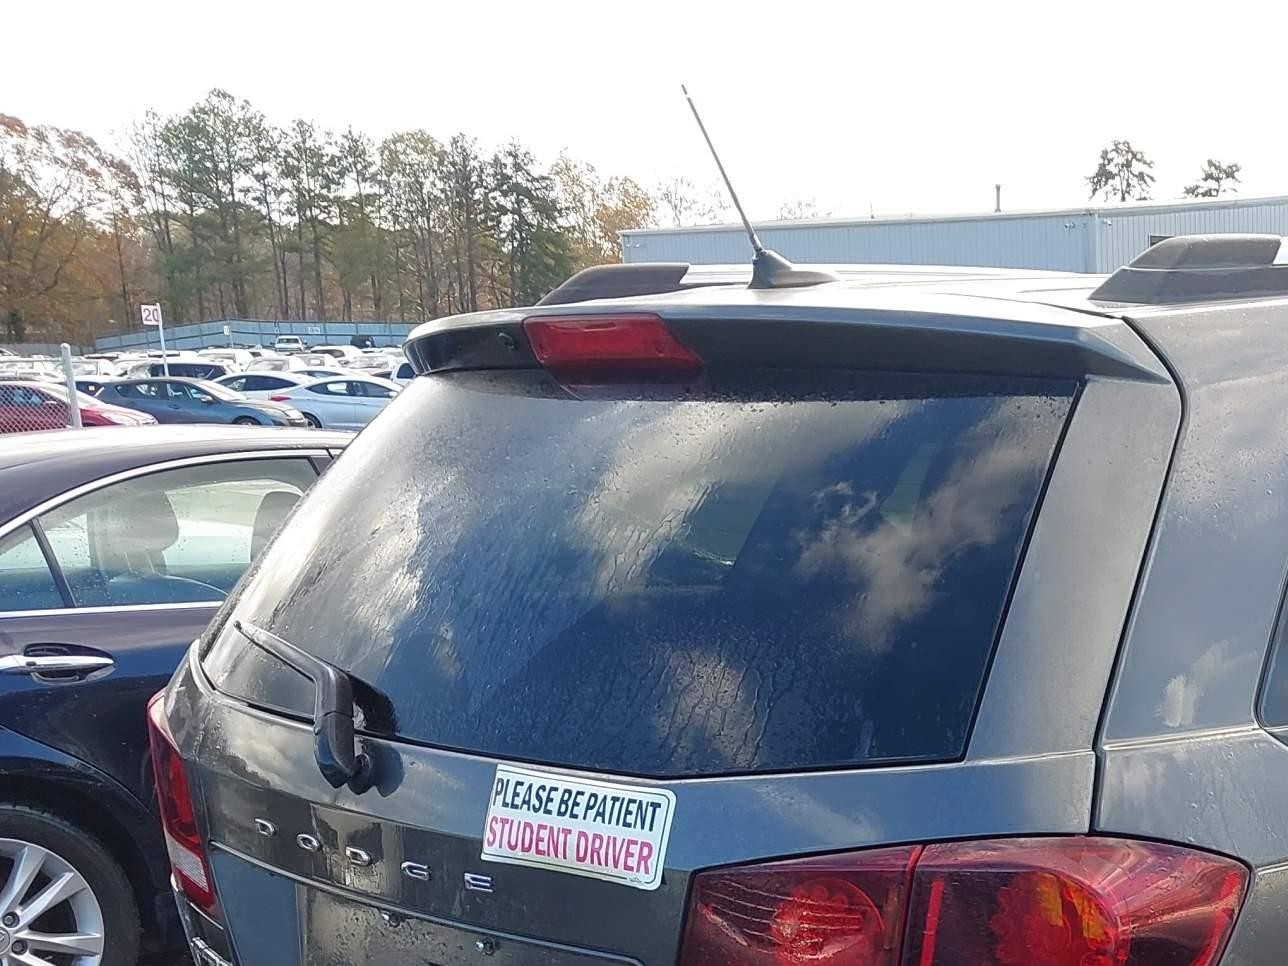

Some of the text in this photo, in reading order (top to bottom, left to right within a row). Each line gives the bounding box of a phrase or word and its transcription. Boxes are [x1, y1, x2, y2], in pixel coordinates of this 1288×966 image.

[493, 777, 662, 832] PLEASE BE PATIENT
[254, 818, 494, 893] DODGE
[486, 815, 654, 875] STUDENT DRIVER
